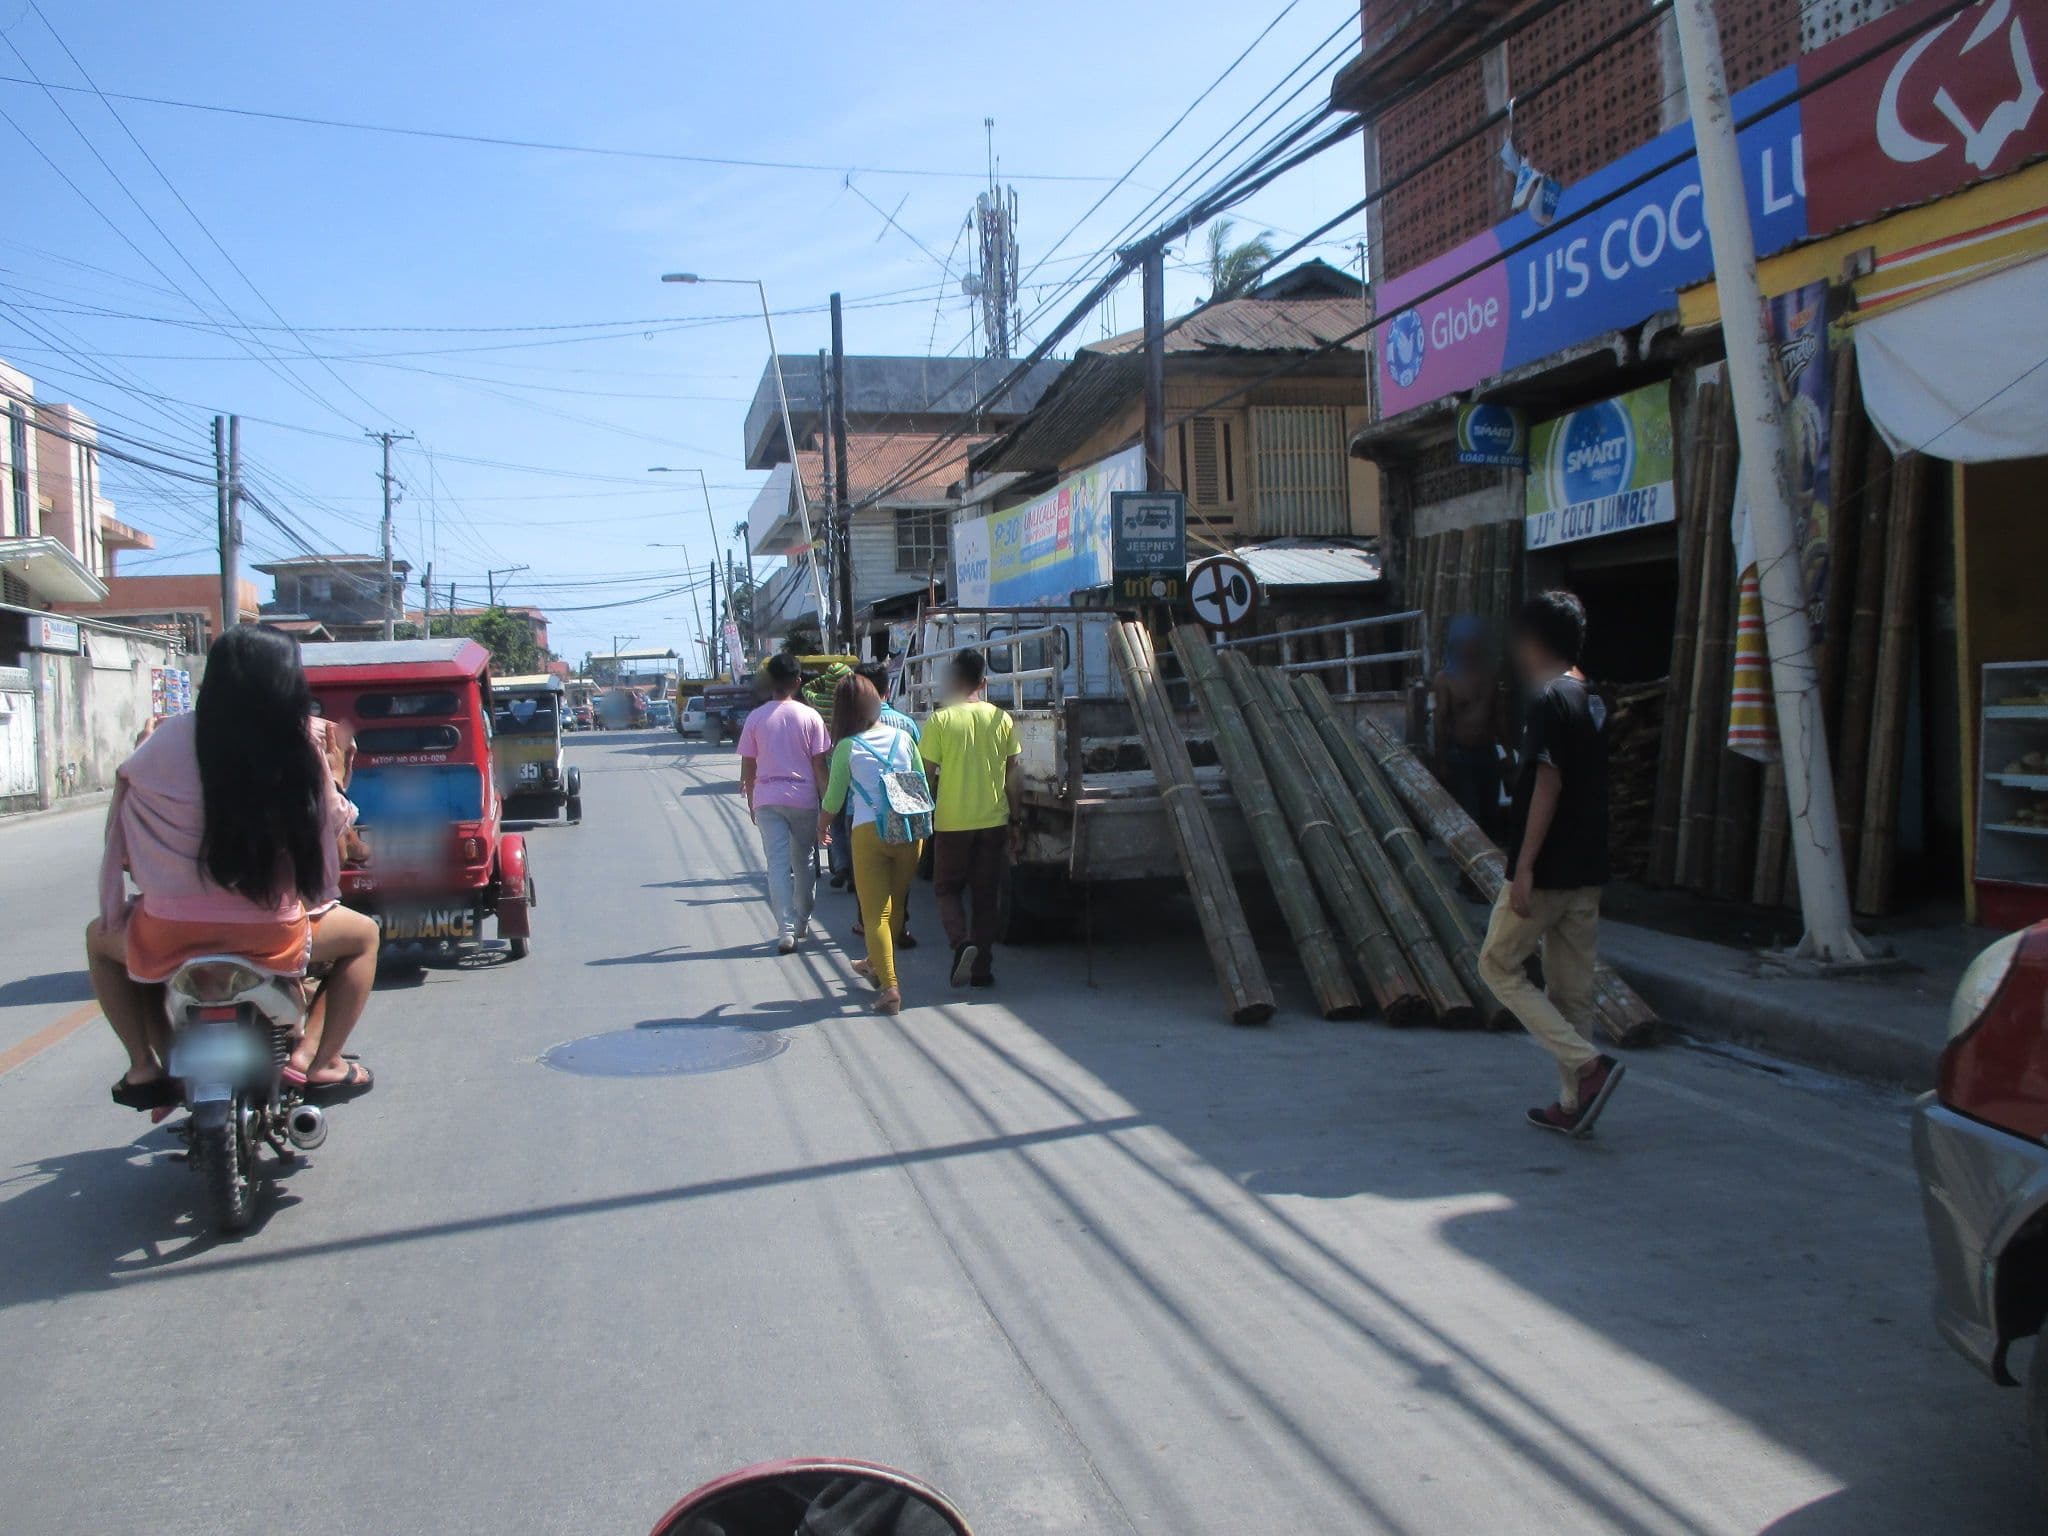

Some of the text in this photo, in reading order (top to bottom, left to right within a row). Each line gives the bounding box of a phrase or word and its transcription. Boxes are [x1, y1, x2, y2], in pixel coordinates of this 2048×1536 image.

[1521, 237, 1590, 319] JJ'S
[1600, 183, 1709, 280] COC
[1431, 297, 1499, 350] Globe
[1472, 424, 1513, 439] SMART
[1567, 436, 1625, 474] SMART
[1560, 501, 1595, 540] COCO
[1599, 486, 1658, 532] LUMBER
[1126, 541, 1176, 551] JEEPNEY
[519, 762, 537, 779] 35
